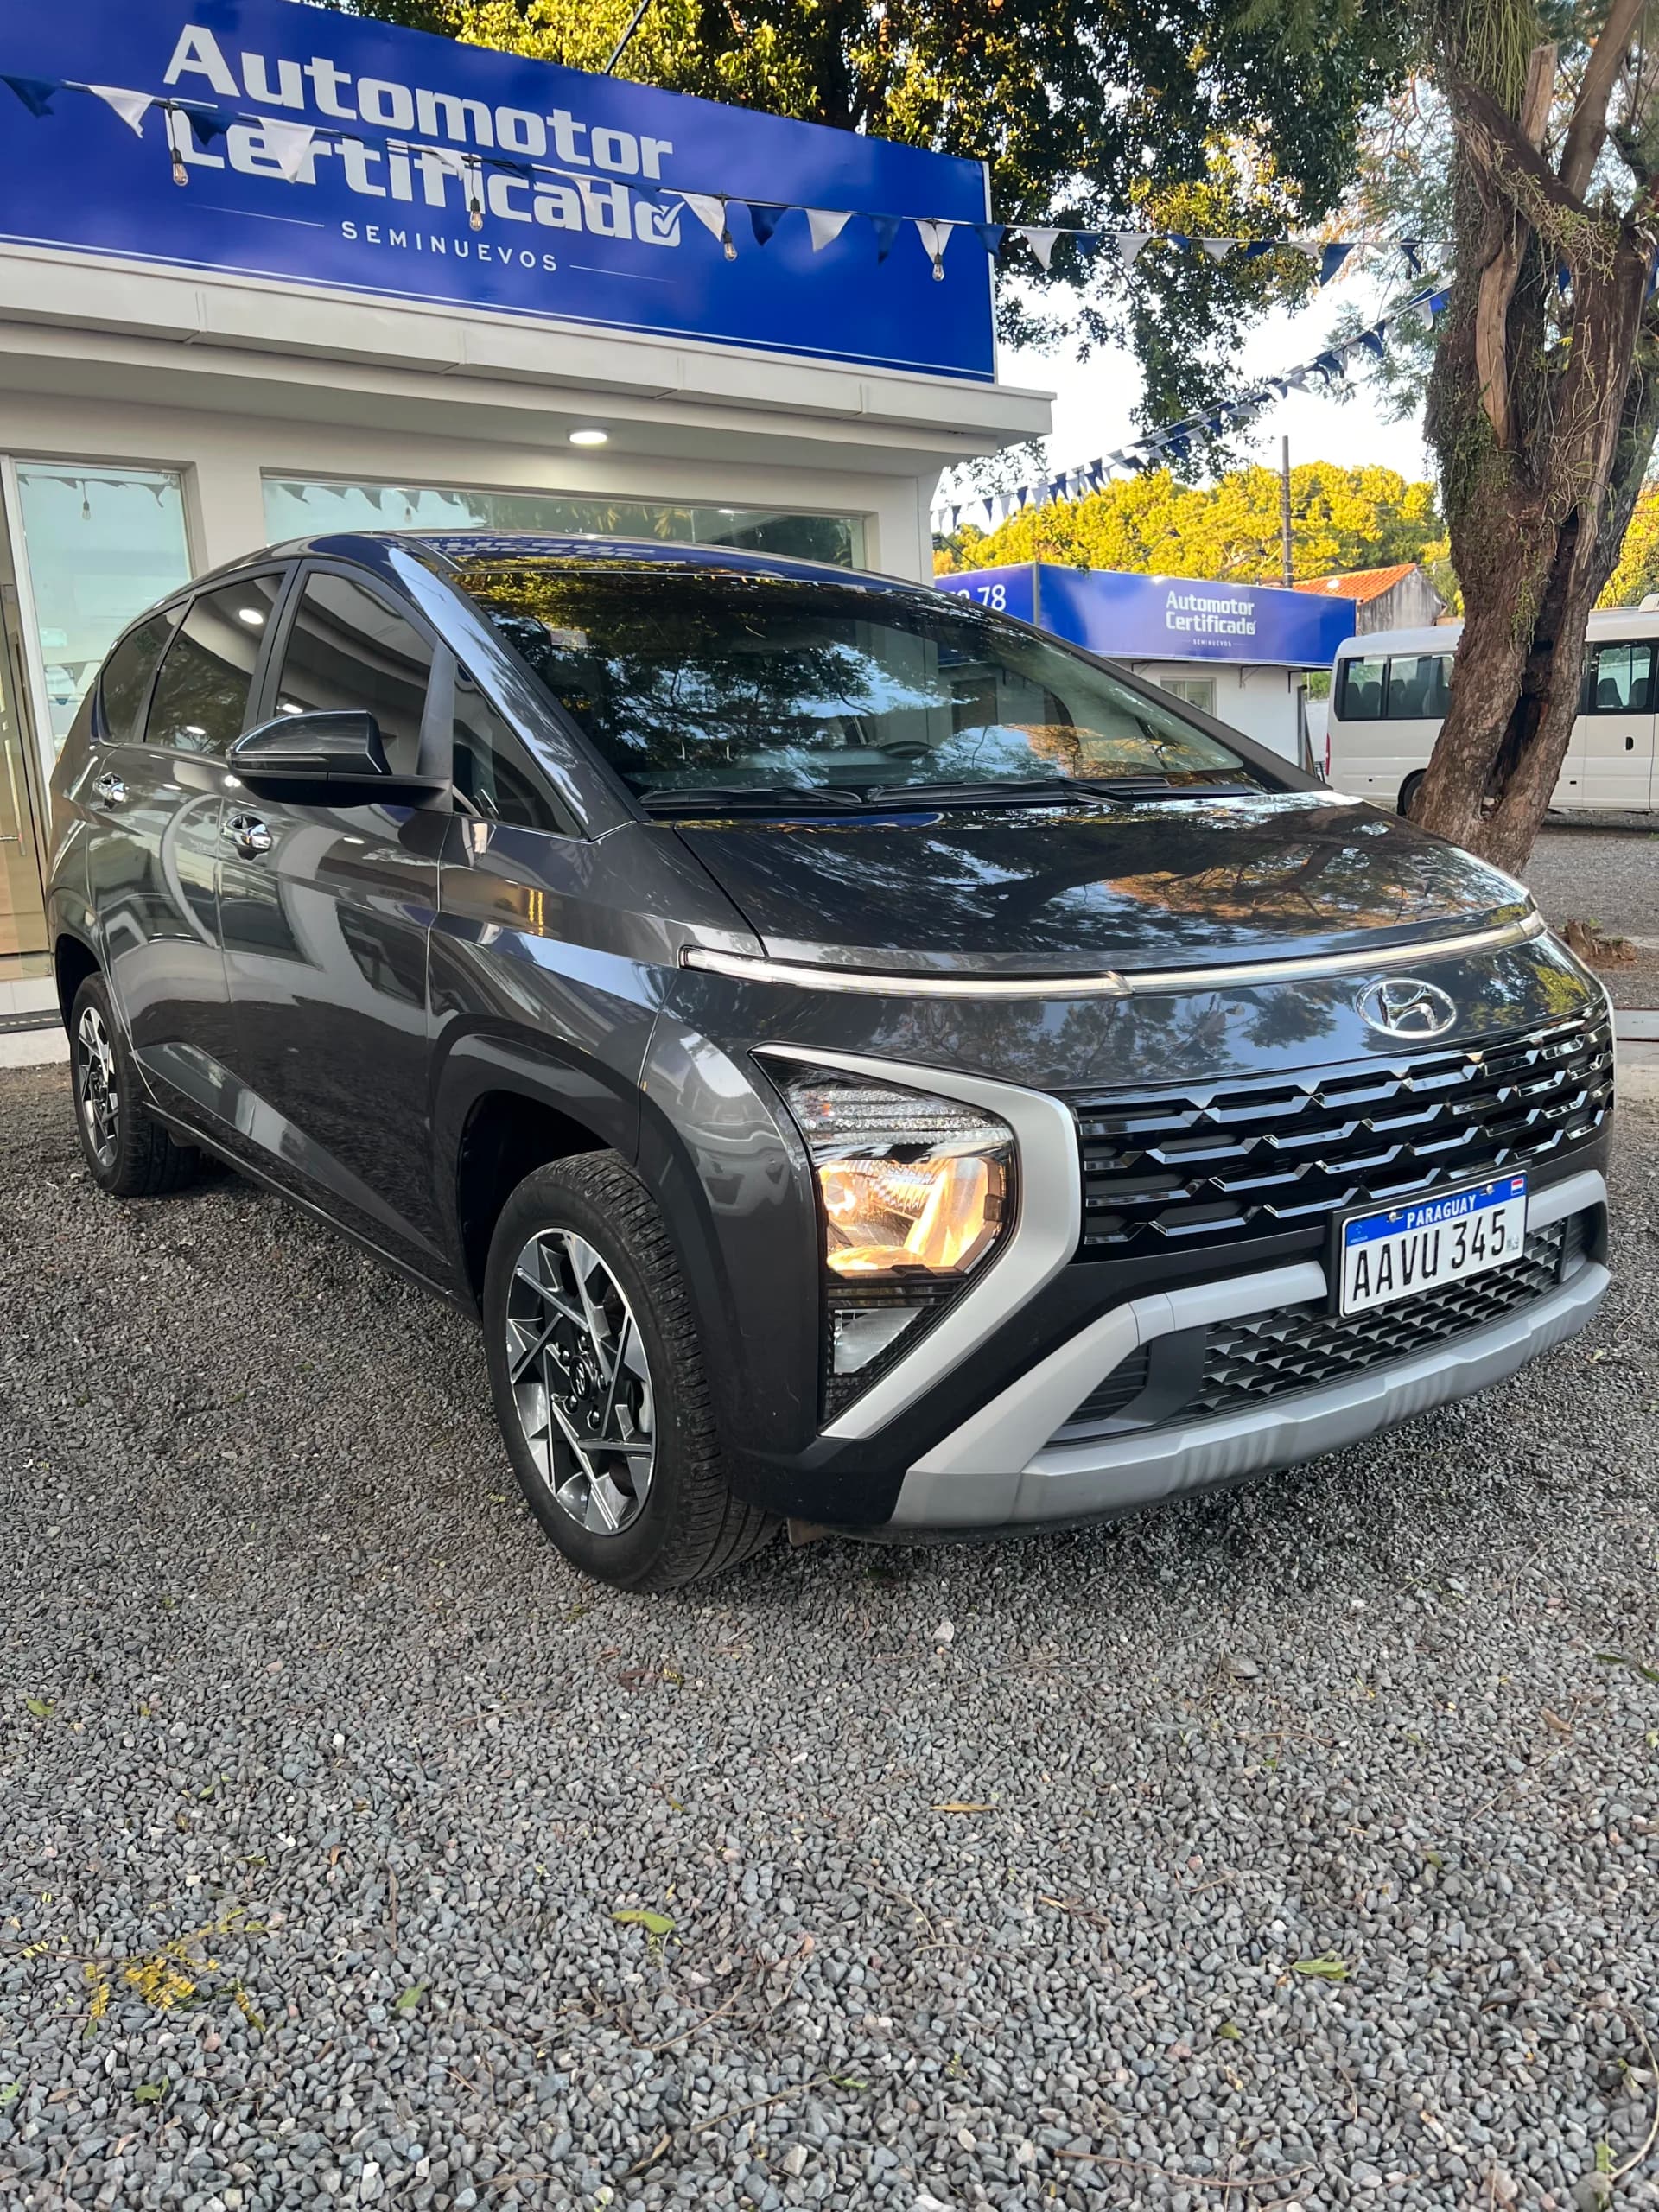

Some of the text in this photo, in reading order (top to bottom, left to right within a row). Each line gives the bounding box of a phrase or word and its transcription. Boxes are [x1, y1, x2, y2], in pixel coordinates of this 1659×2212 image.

[163, 23, 673, 180] Automotor
[164, 98, 683, 248] Certificado
[341, 220, 558, 272] SEMINUEVOS
[976, 583, 1007, 612] 78
[1166, 590, 1255, 616] Automotor
[1166, 611, 1257, 636] Certificado
[1192, 638, 1232, 647] SEMINUEVOS
[1406, 1194, 1477, 1230] PARAGUAY
[1352, 1208, 1506, 1302] AAVU 345
